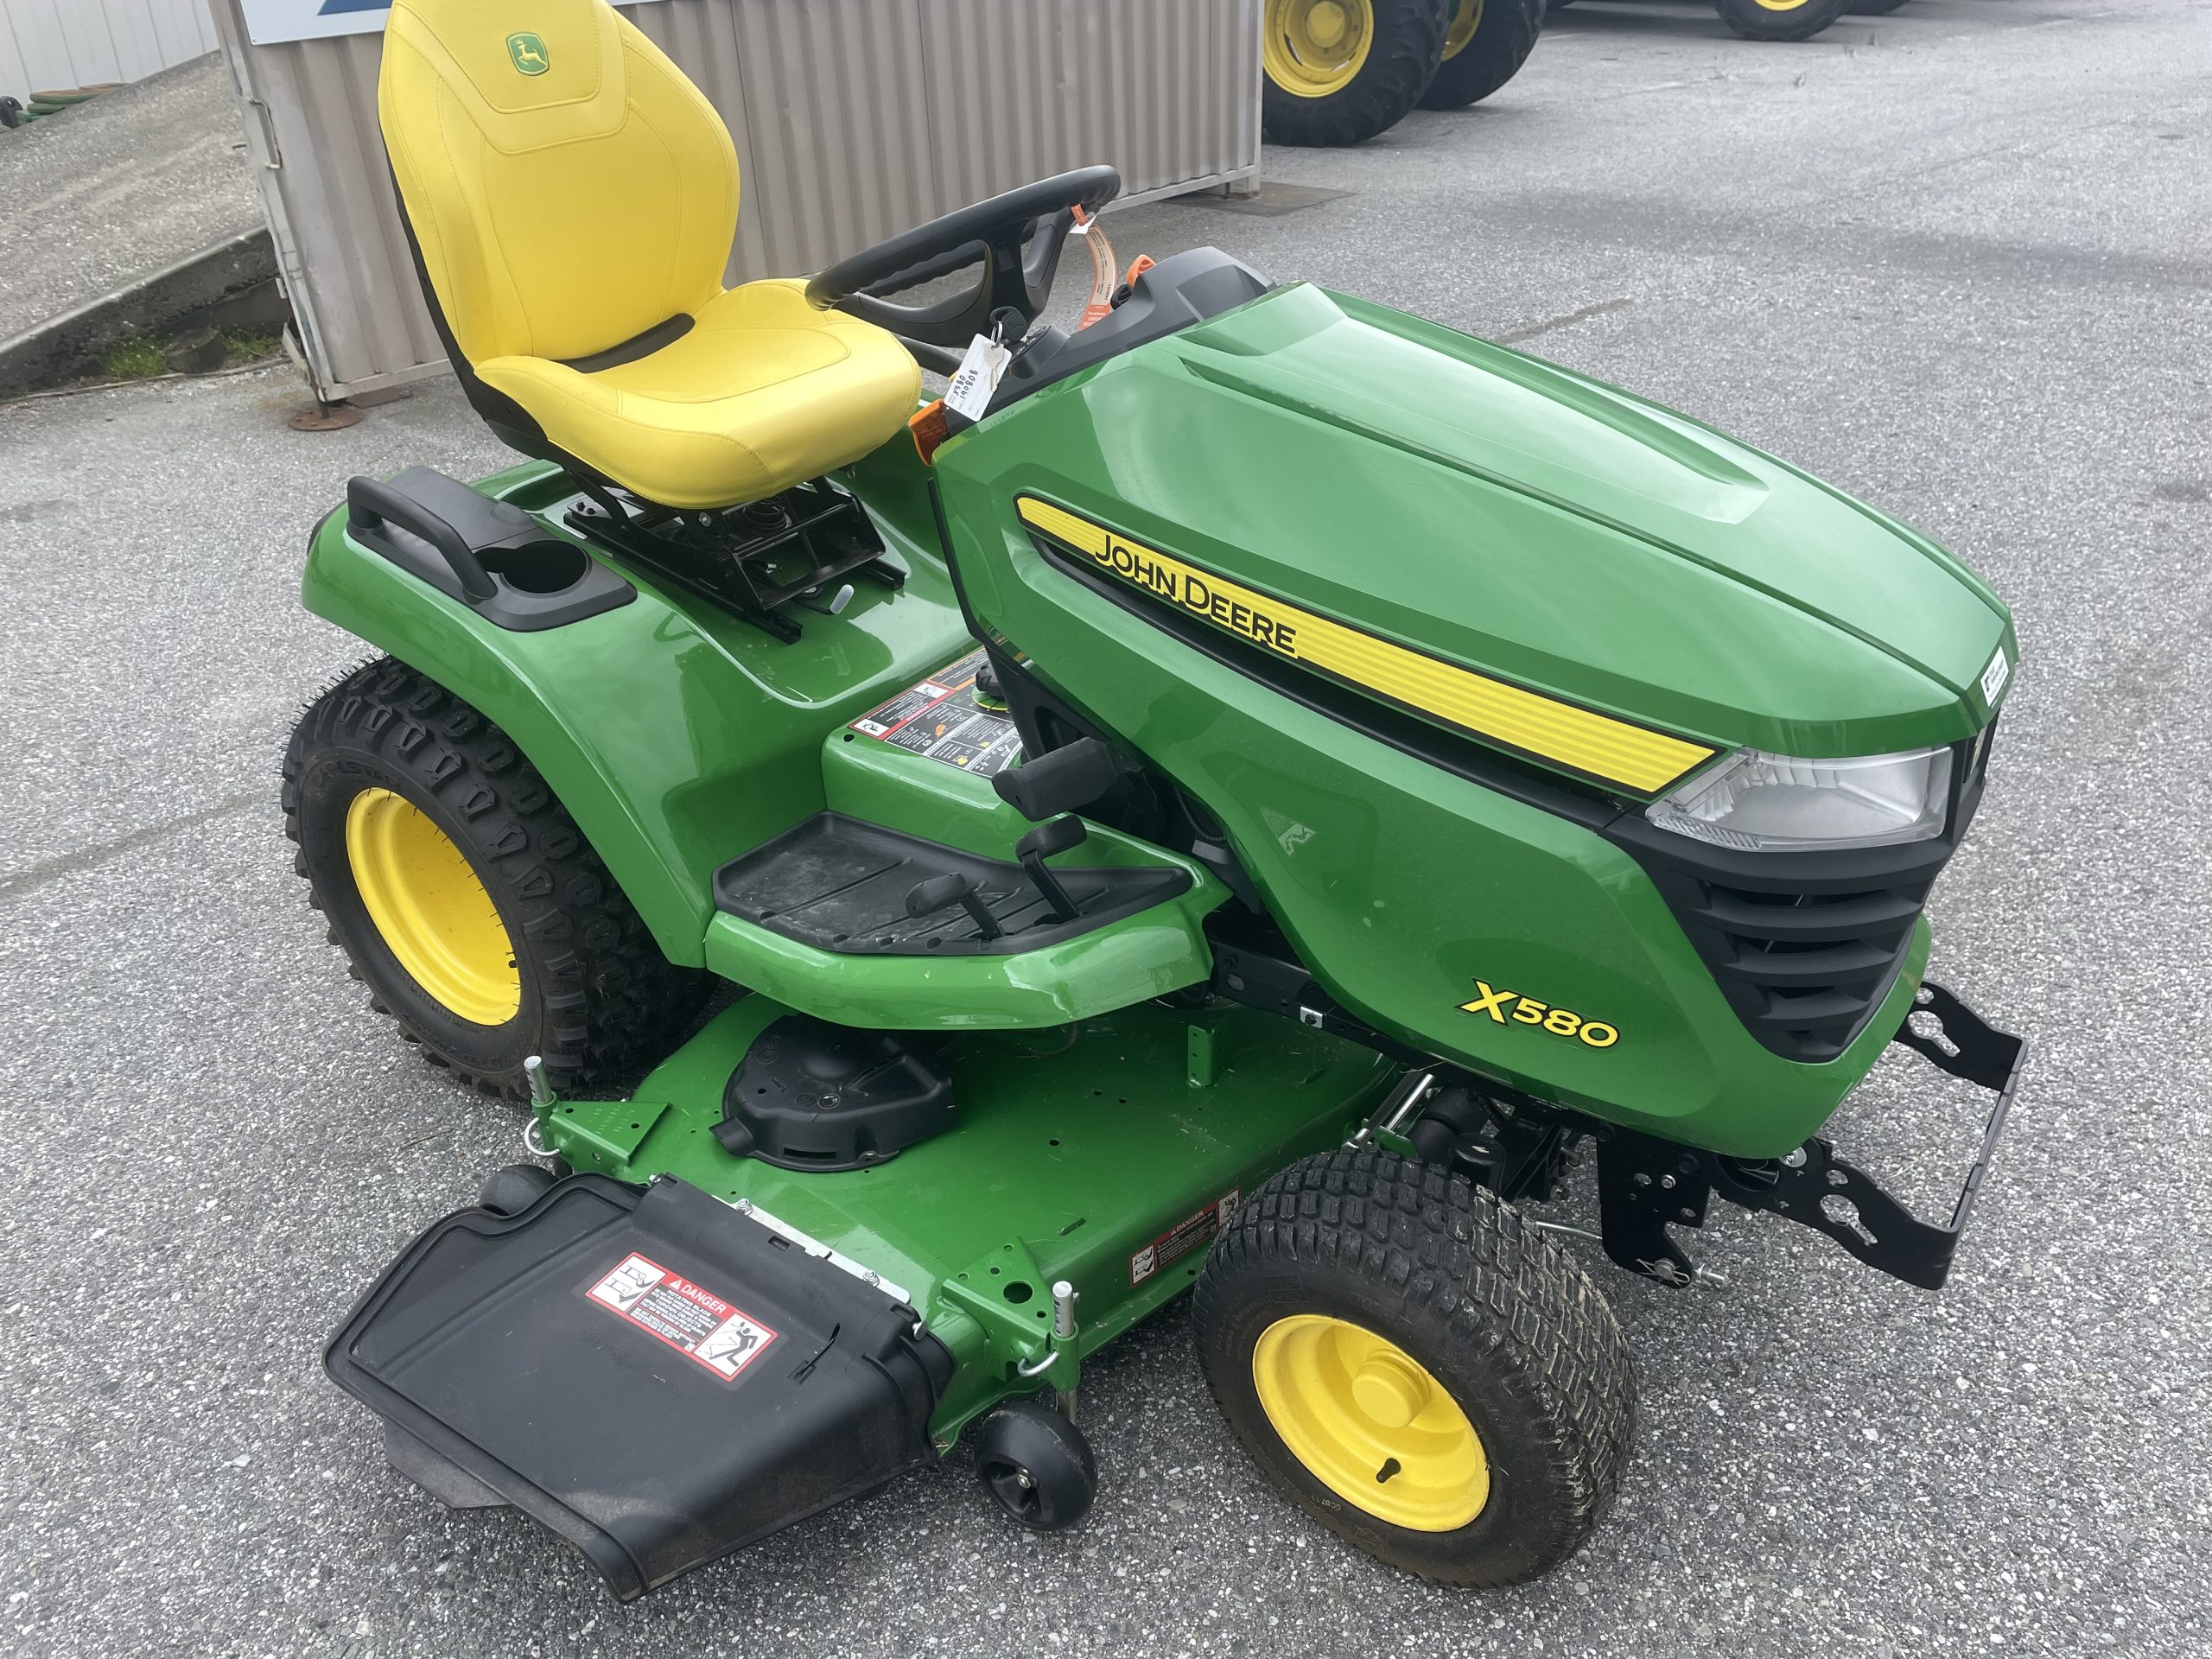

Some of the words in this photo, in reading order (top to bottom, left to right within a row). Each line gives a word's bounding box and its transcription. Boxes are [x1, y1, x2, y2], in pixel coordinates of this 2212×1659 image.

[1095, 534, 1177, 600] JOHN
[1185, 574, 1298, 656] DEERE
[1454, 976, 1620, 1049] X580
[1177, 1211, 1204, 1230] DANGER
[654, 1298, 678, 1314] THROWN
[676, 1311, 702, 1328] OBJECTS
[665, 1289, 694, 1306] ROTATING
[691, 1304, 712, 1317] BLADE
[679, 1283, 728, 1314] DANGER
